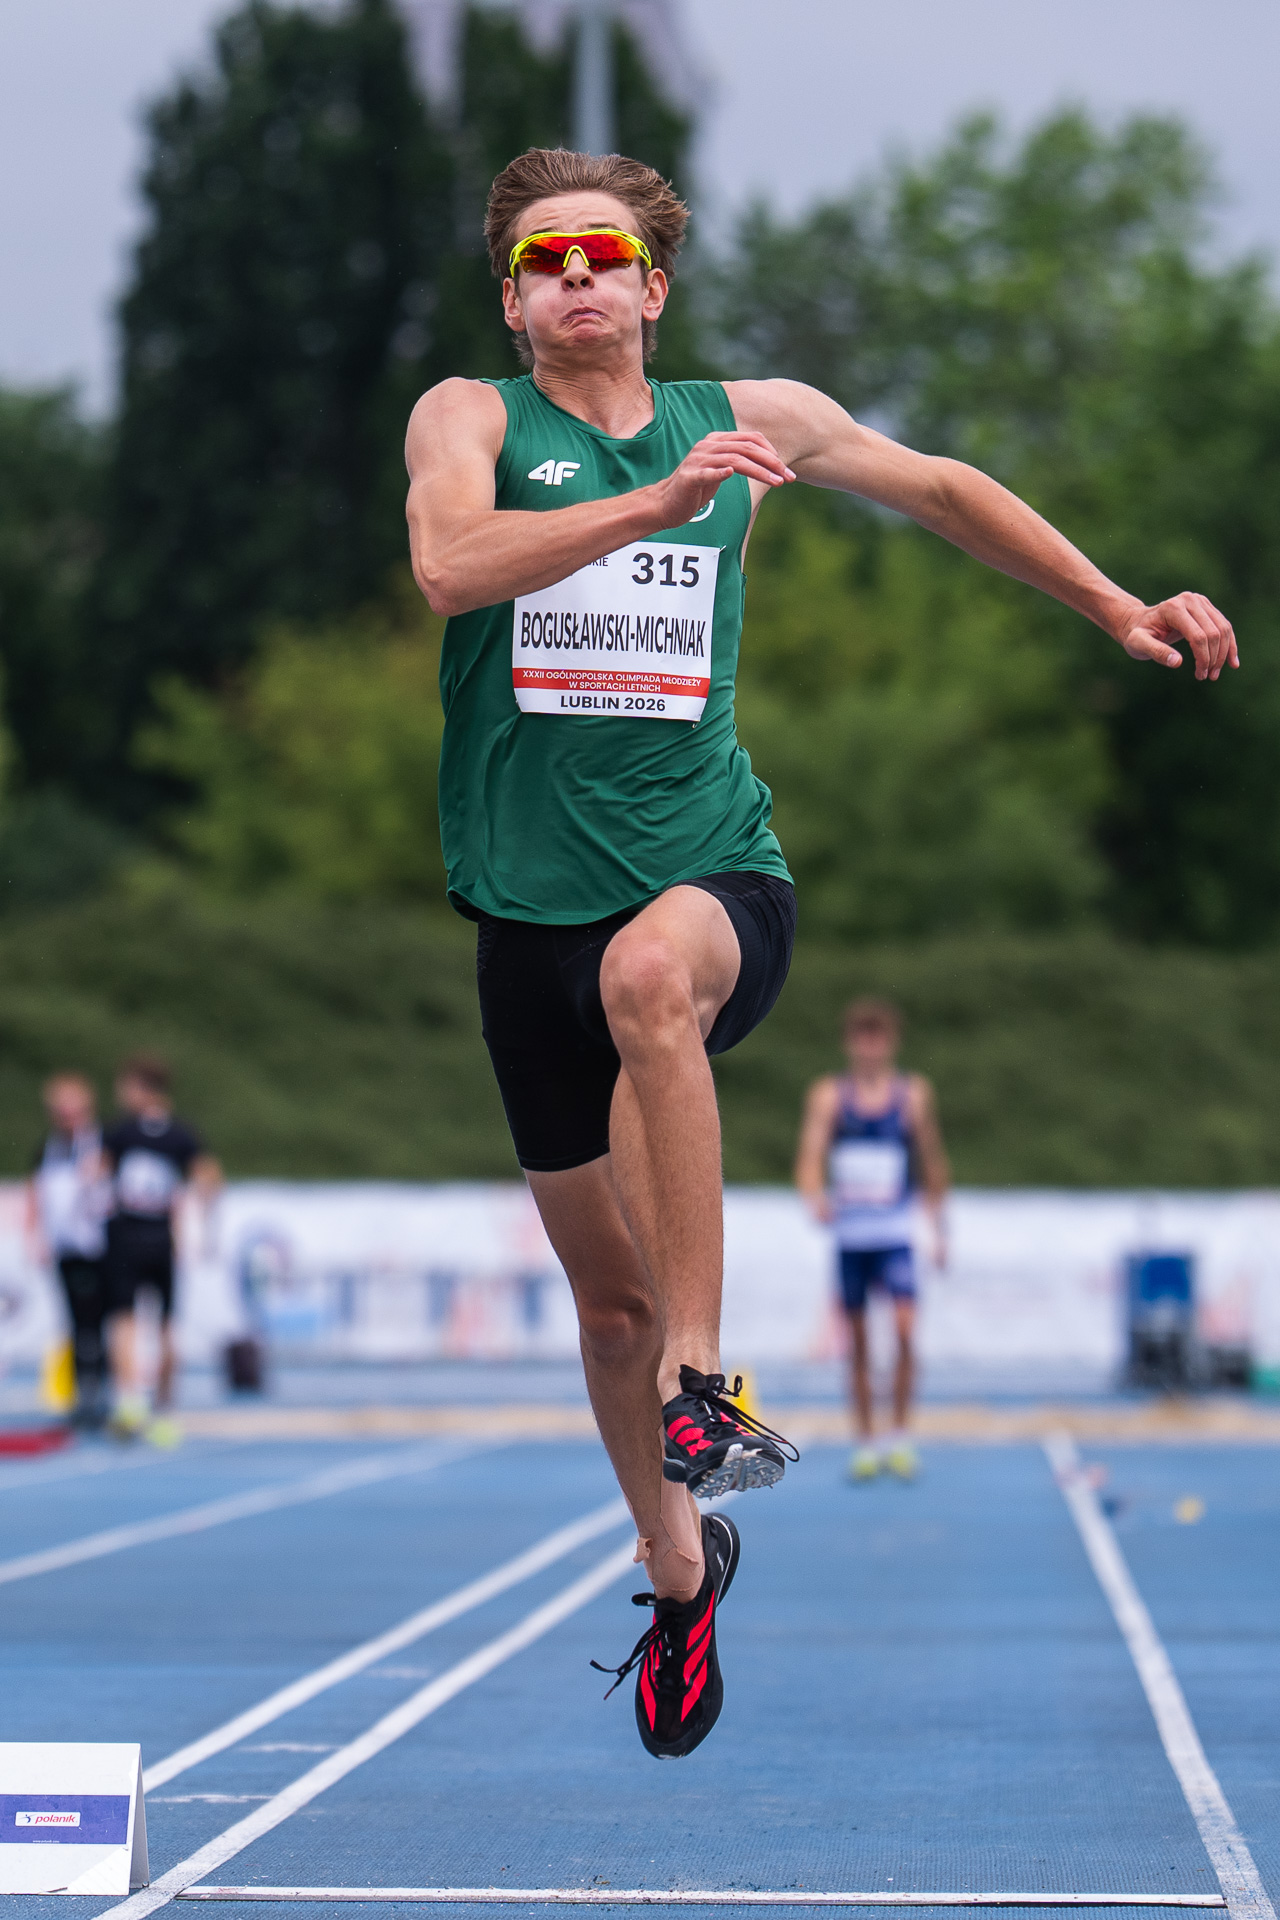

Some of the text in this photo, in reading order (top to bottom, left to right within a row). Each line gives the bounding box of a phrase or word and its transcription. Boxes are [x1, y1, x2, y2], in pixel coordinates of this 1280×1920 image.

[527, 459, 581, 486] 4F
[588, 557, 609, 567] KIE
[631, 552, 700, 588] 315
[520, 611, 706, 658] BOGUSŁAWSKI-MICHNIAK
[522, 670, 702, 687] XXXII OGÓLNOPOLSKA OLIMPIADA MŁODZIEŻY
[569, 681, 661, 692] W SPORTACH LETNICH
[560, 695, 666, 712] LUBLIN 2026
